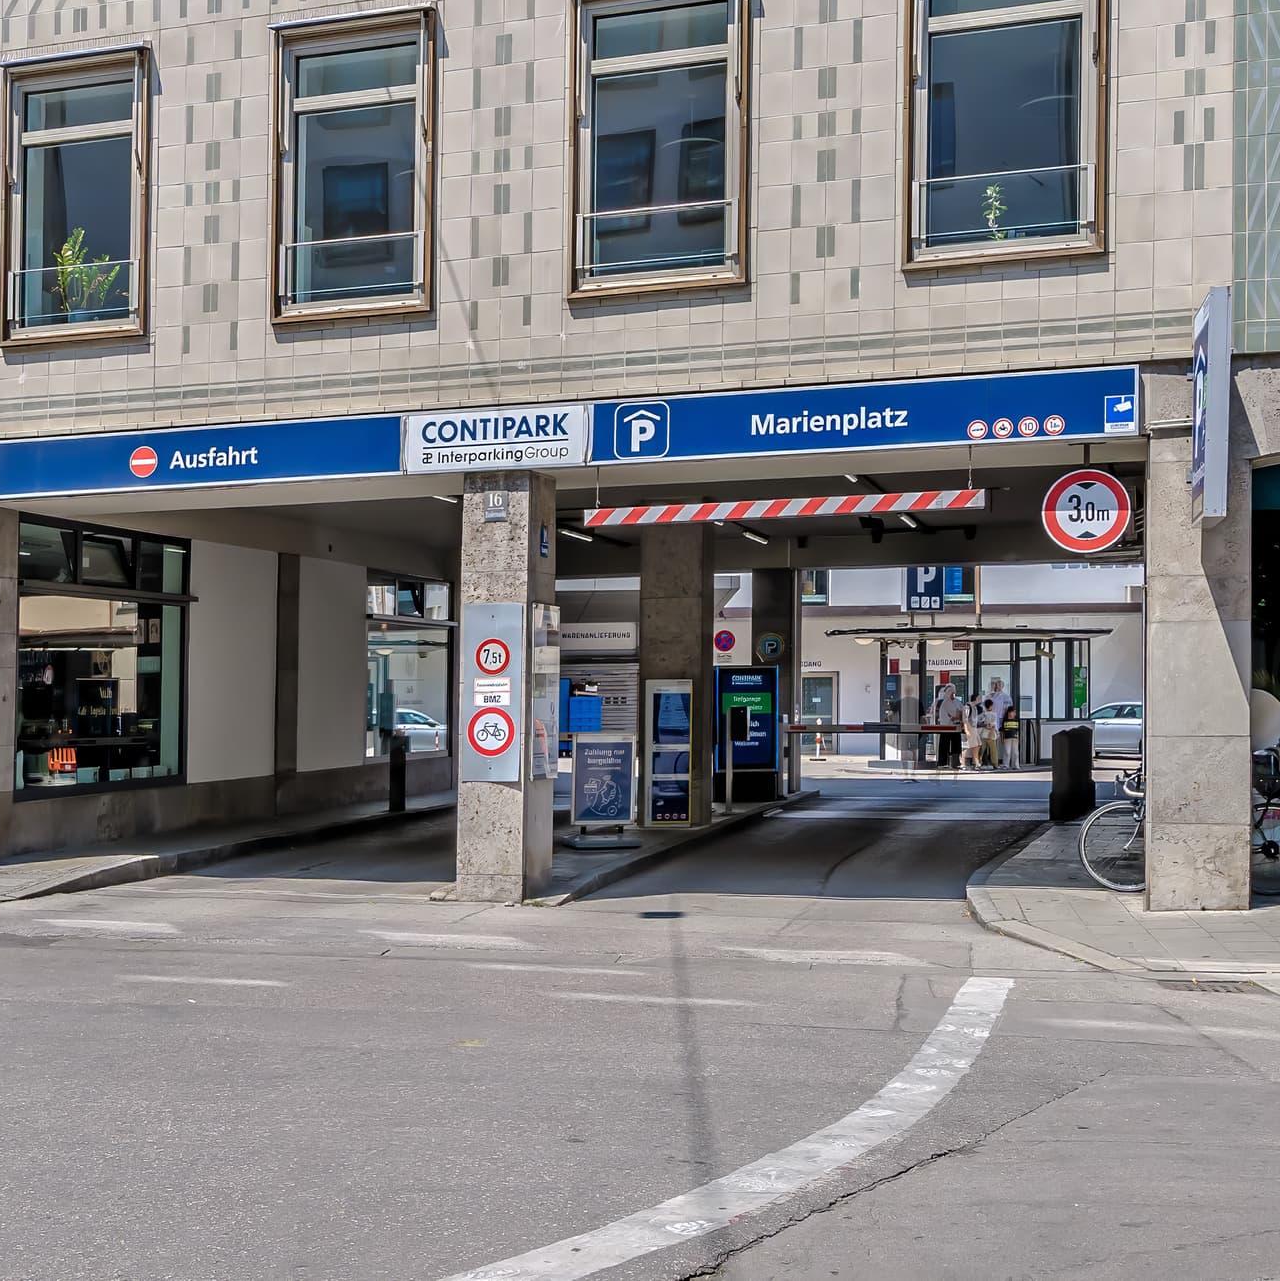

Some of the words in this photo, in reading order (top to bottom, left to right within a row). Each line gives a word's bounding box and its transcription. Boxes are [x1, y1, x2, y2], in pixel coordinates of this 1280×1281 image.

[421, 413, 570, 444] CONTIPARK
[750, 406, 909, 436] Marienplatz
[169, 445, 258, 471] Ausfahrt
[489, 493, 503, 507] 16
[1067, 493, 1110, 523] 3,0m
[561, 631, 631, 639] WARENANLIEFERUNG
[483, 648, 503, 665] 7,5t
